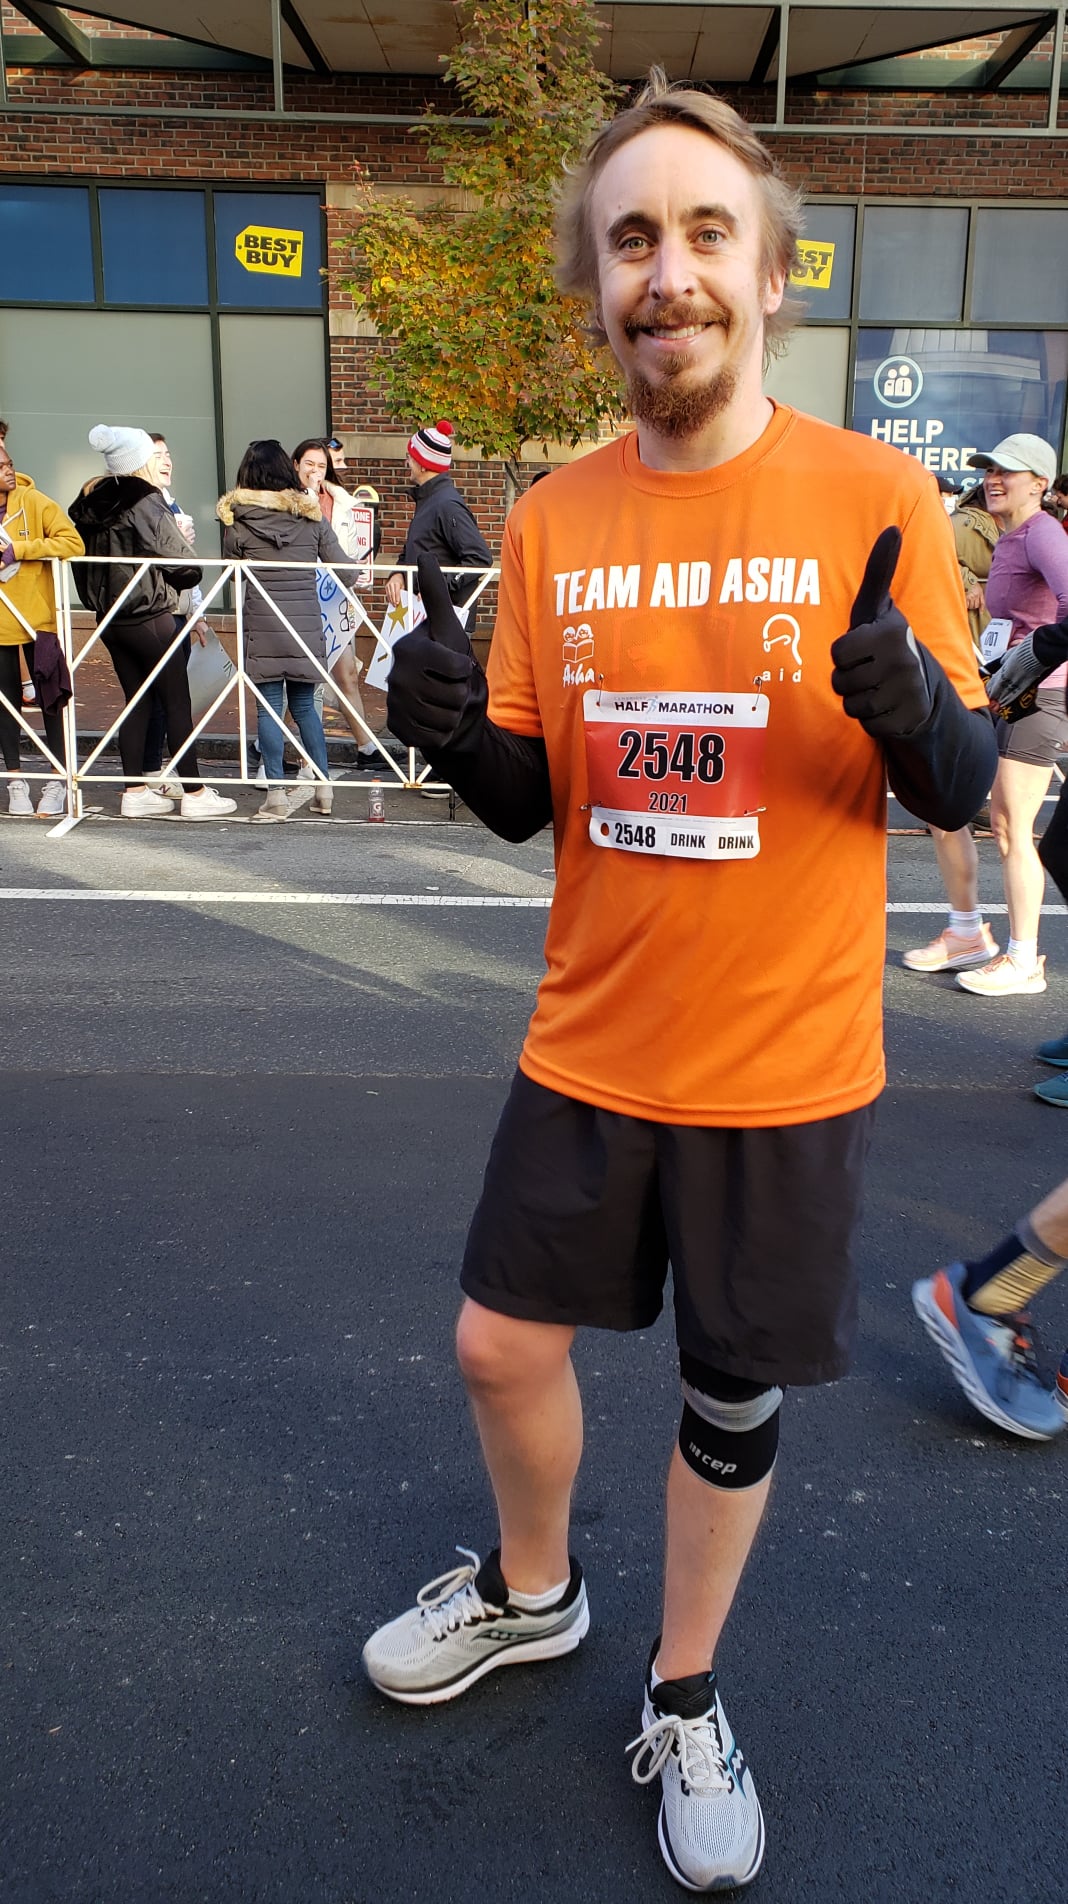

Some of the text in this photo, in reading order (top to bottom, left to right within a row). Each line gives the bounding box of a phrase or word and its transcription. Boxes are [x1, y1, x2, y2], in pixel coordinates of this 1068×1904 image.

[244, 234, 301, 254] BEST
[246, 249, 296, 268] BUY
[798, 248, 832, 266] EST
[791, 265, 826, 280] UY
[871, 419, 944, 443] HELP
[353, 511, 370, 522] ONE
[554, 557, 821, 617] TEAM AID ASHA
[563, 664, 595, 688] Asha
[762, 668, 802, 683] aid
[614, 701, 734, 715] HALF MARATHON
[617, 729, 725, 784] 2548
[648, 792, 688, 813] 2021
[614, 822, 755, 850] 2548 DRINK DRINK
[702, 1454, 738, 1475] cep
